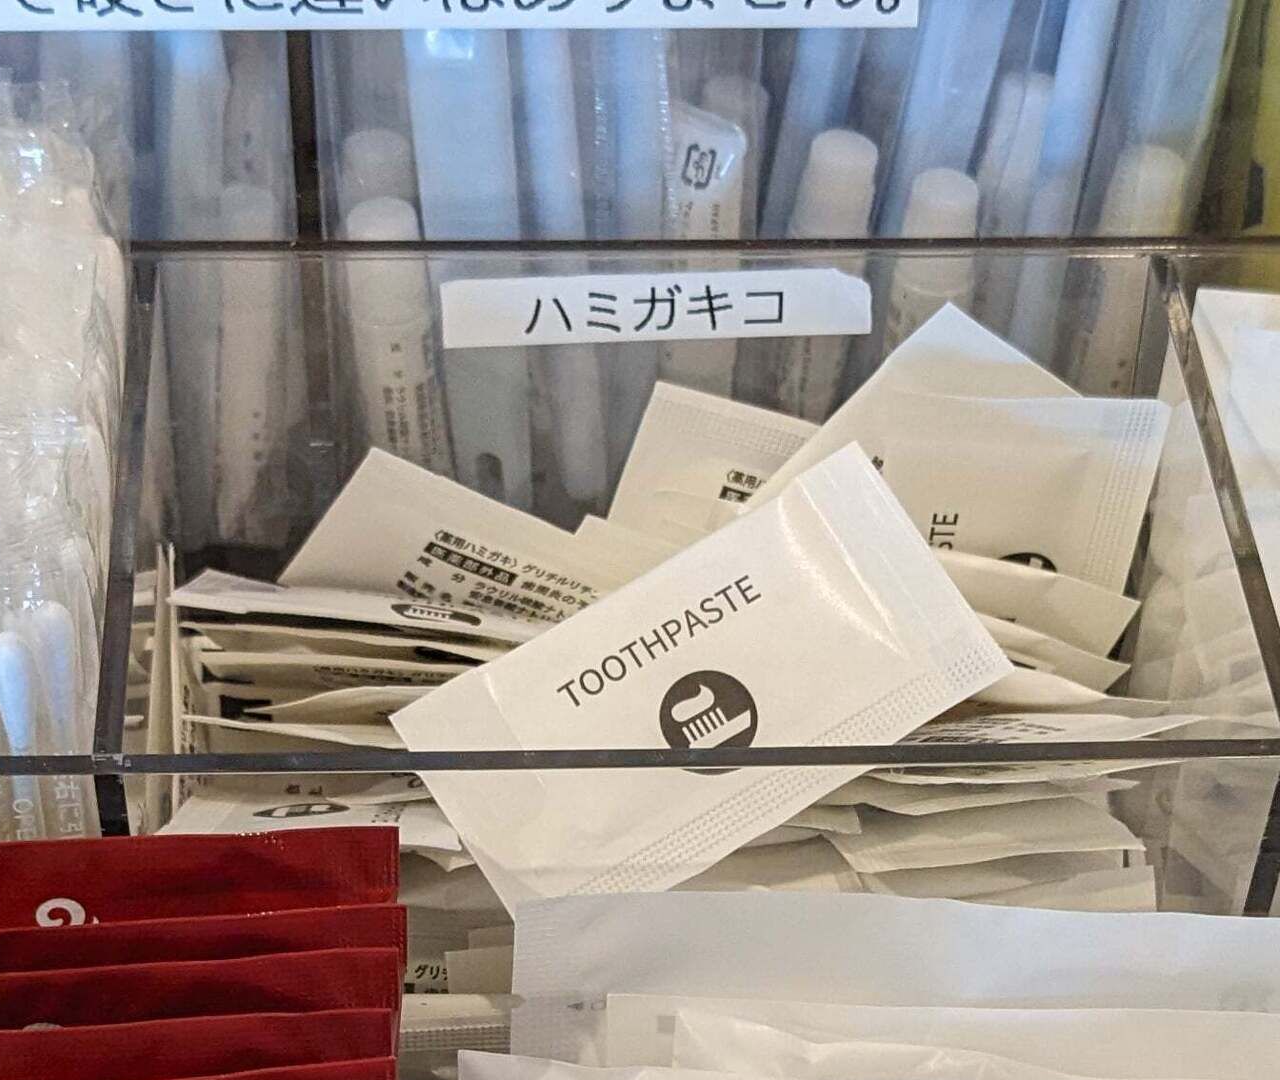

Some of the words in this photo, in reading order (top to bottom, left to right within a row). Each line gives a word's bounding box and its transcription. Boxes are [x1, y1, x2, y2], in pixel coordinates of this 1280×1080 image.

[524, 283, 784, 334] ハミガキコ
[556, 574, 762, 707] TOOTHPASTE
